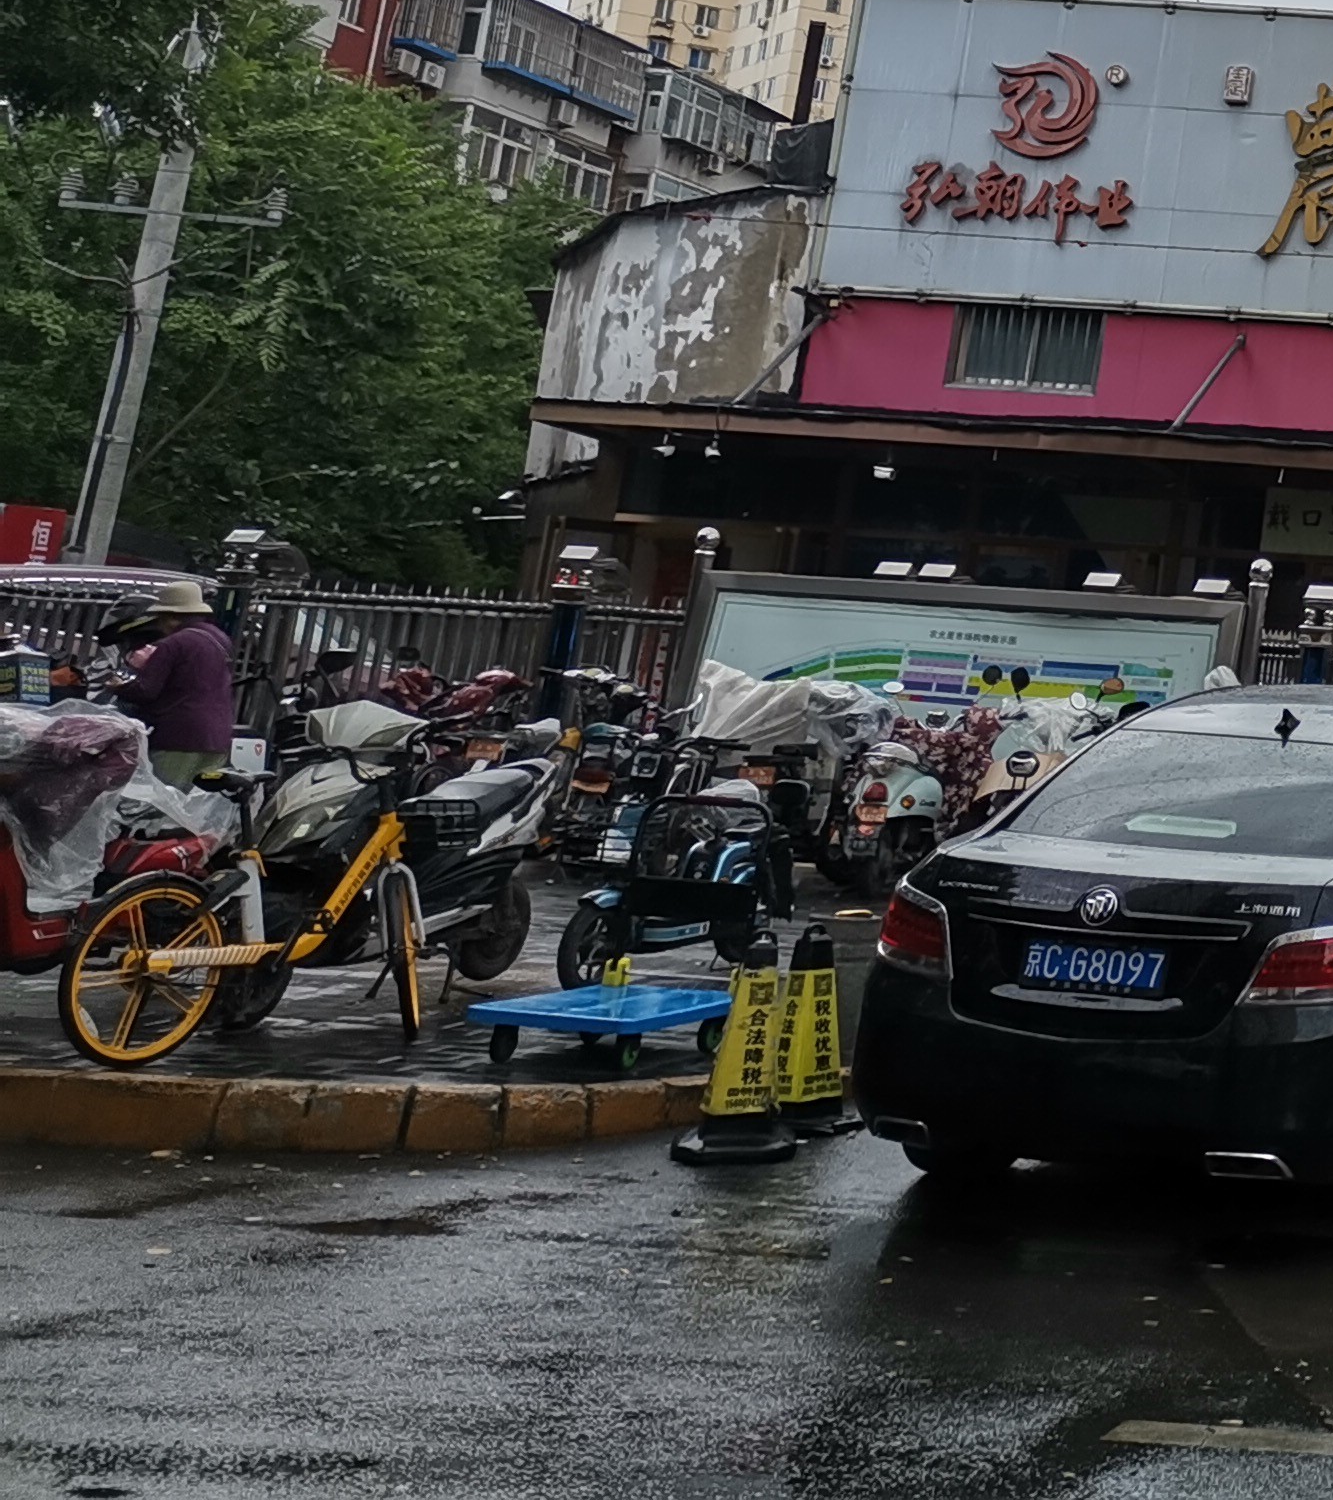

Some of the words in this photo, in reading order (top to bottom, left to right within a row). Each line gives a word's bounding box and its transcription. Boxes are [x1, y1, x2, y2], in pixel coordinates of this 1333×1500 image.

[741, 1008, 769, 1085] 合法降税
[813, 999, 833, 1073] 税收优惠
